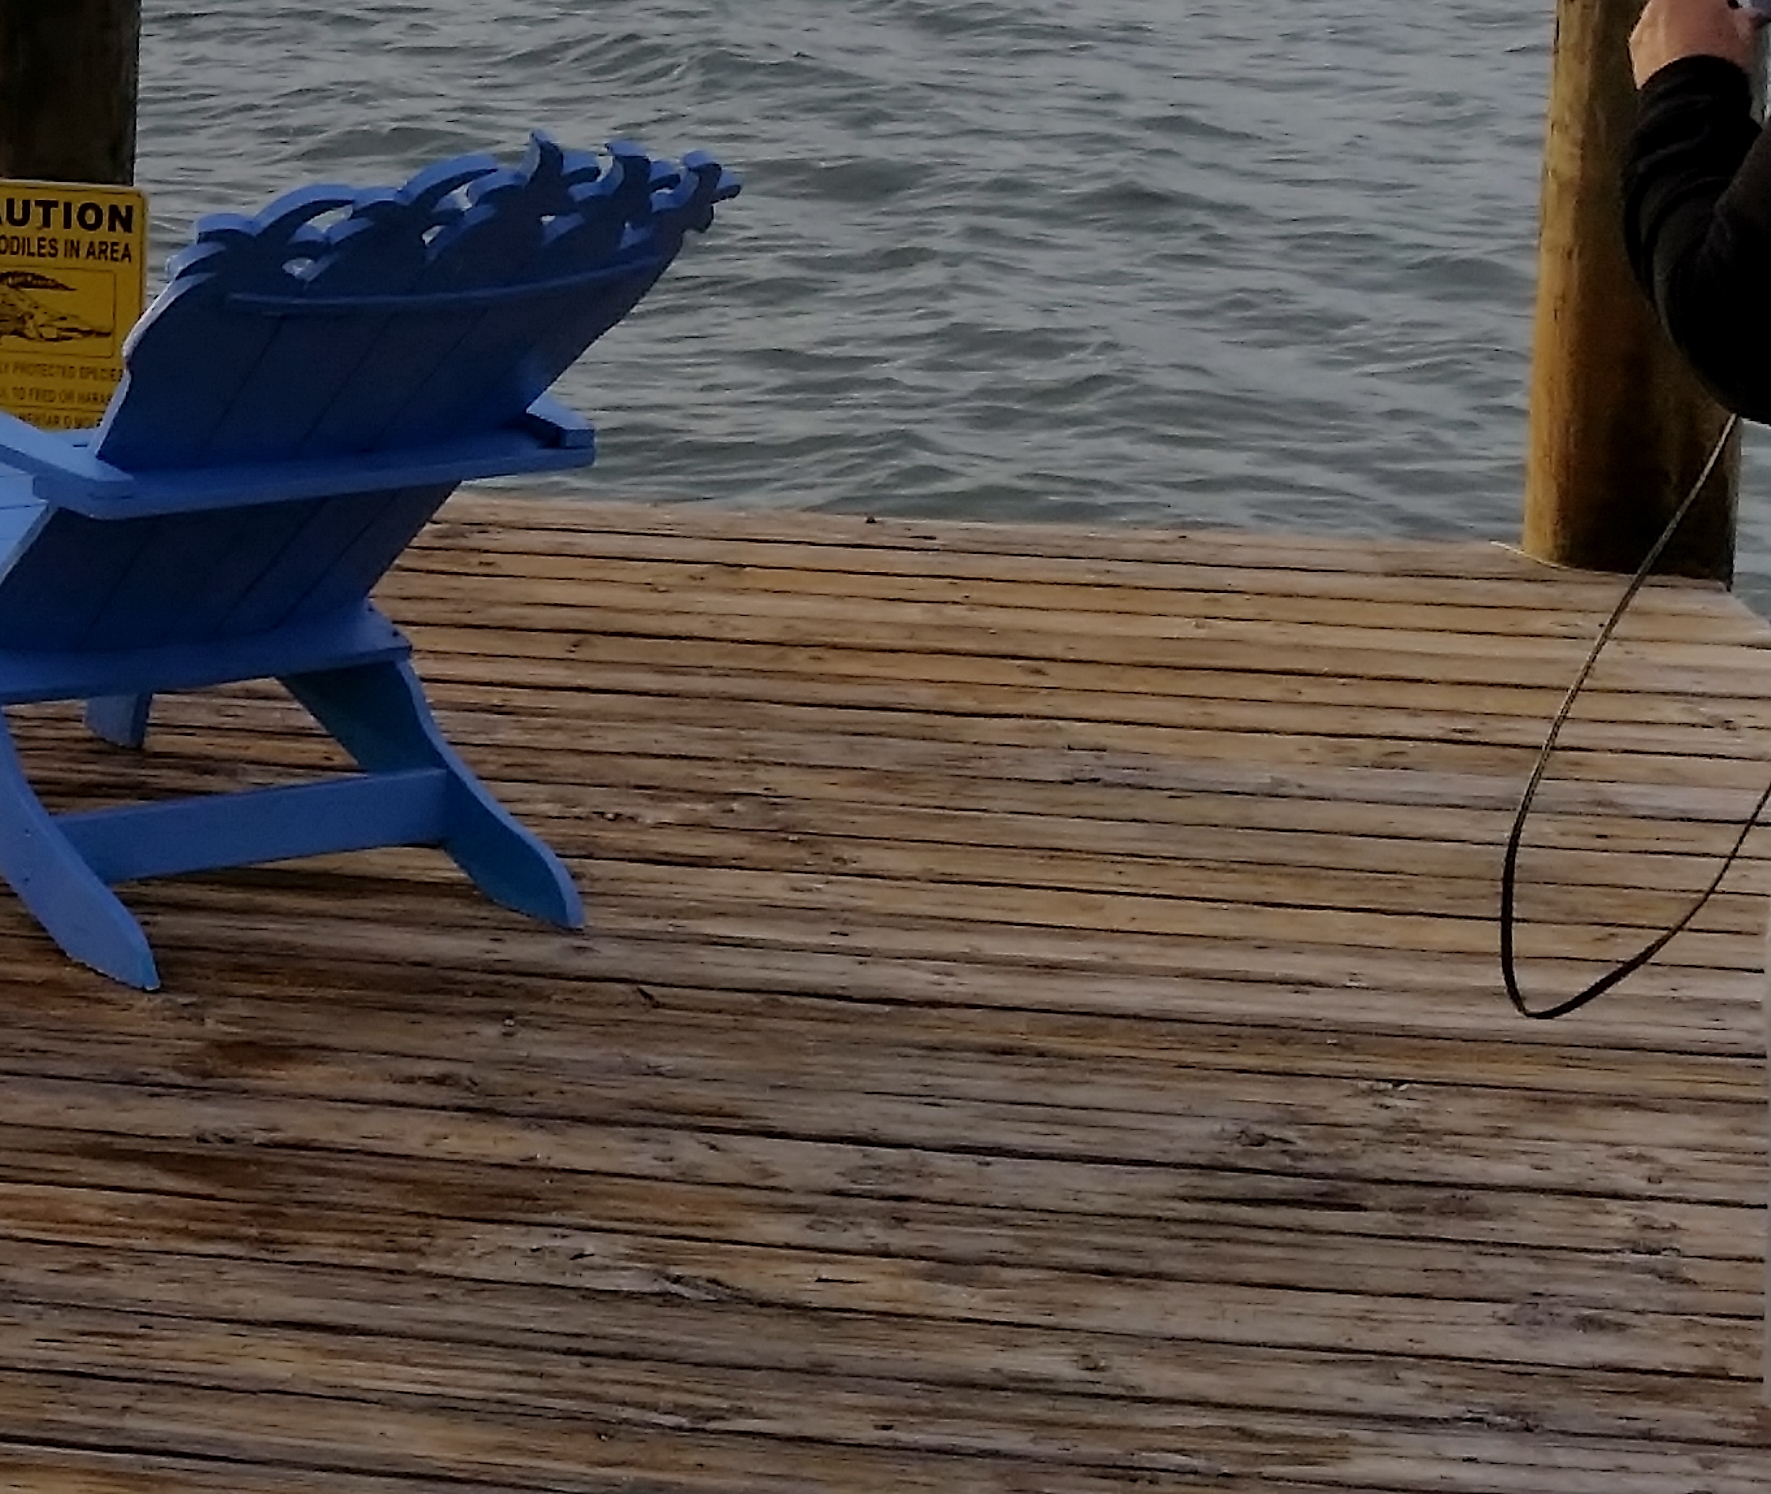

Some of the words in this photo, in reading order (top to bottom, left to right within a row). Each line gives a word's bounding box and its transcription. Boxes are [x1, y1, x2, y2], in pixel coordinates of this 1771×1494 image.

[64, 238, 81, 258] IN
[85, 241, 132, 263] AREA
[12, 360, 75, 380] PROTECTED
